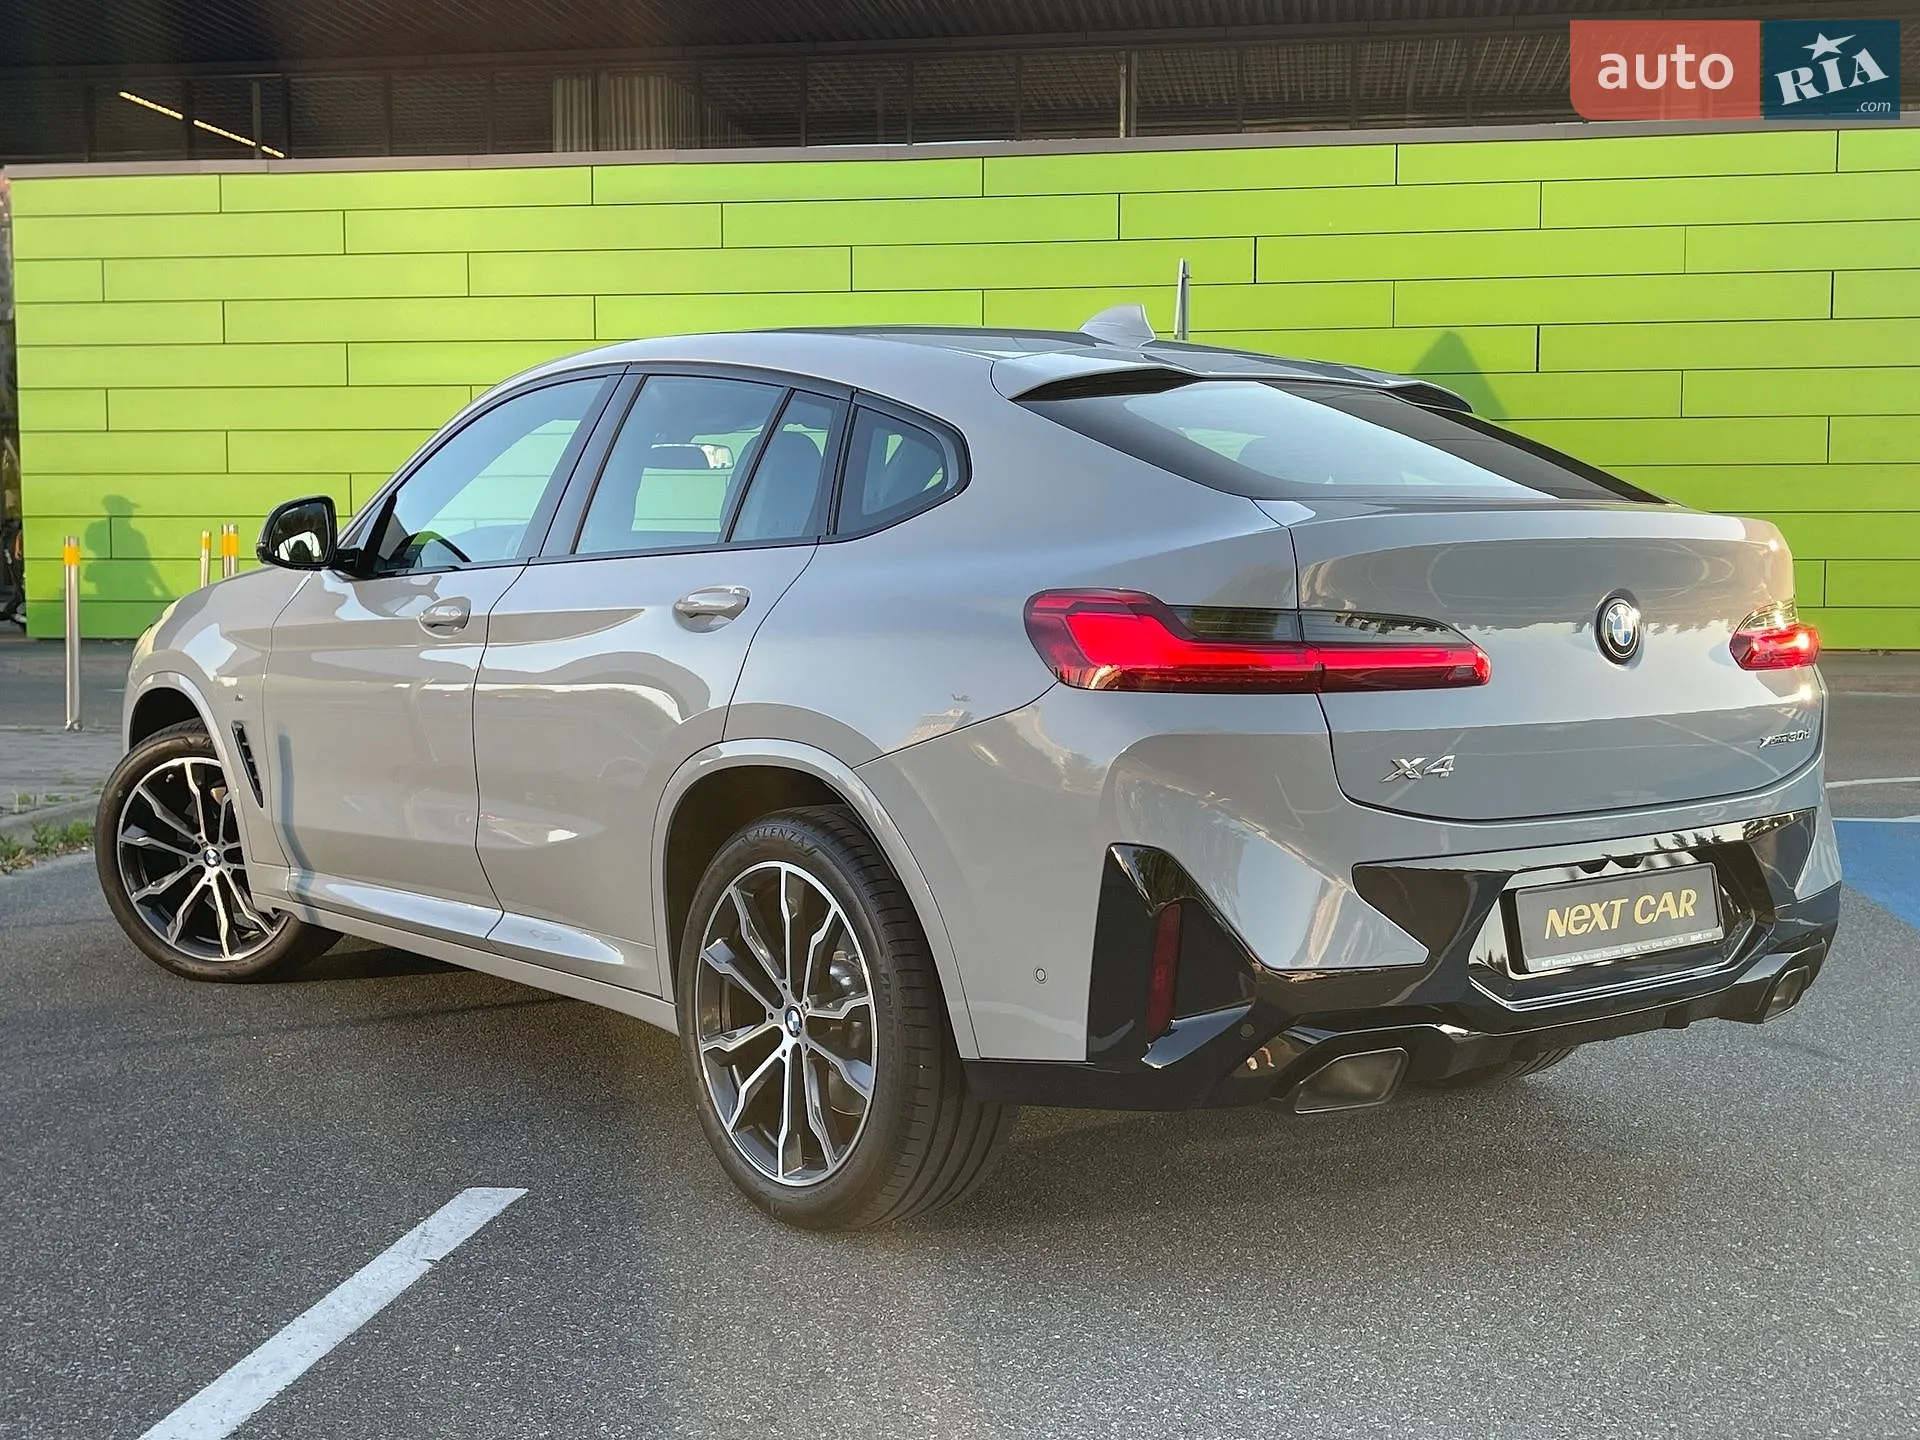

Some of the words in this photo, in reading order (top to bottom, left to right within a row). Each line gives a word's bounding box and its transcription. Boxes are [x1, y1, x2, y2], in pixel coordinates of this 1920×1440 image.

[1380, 754, 1456, 783] X4
[753, 827, 809, 848] ALENZA
[1633, 888, 1697, 925] CAR
